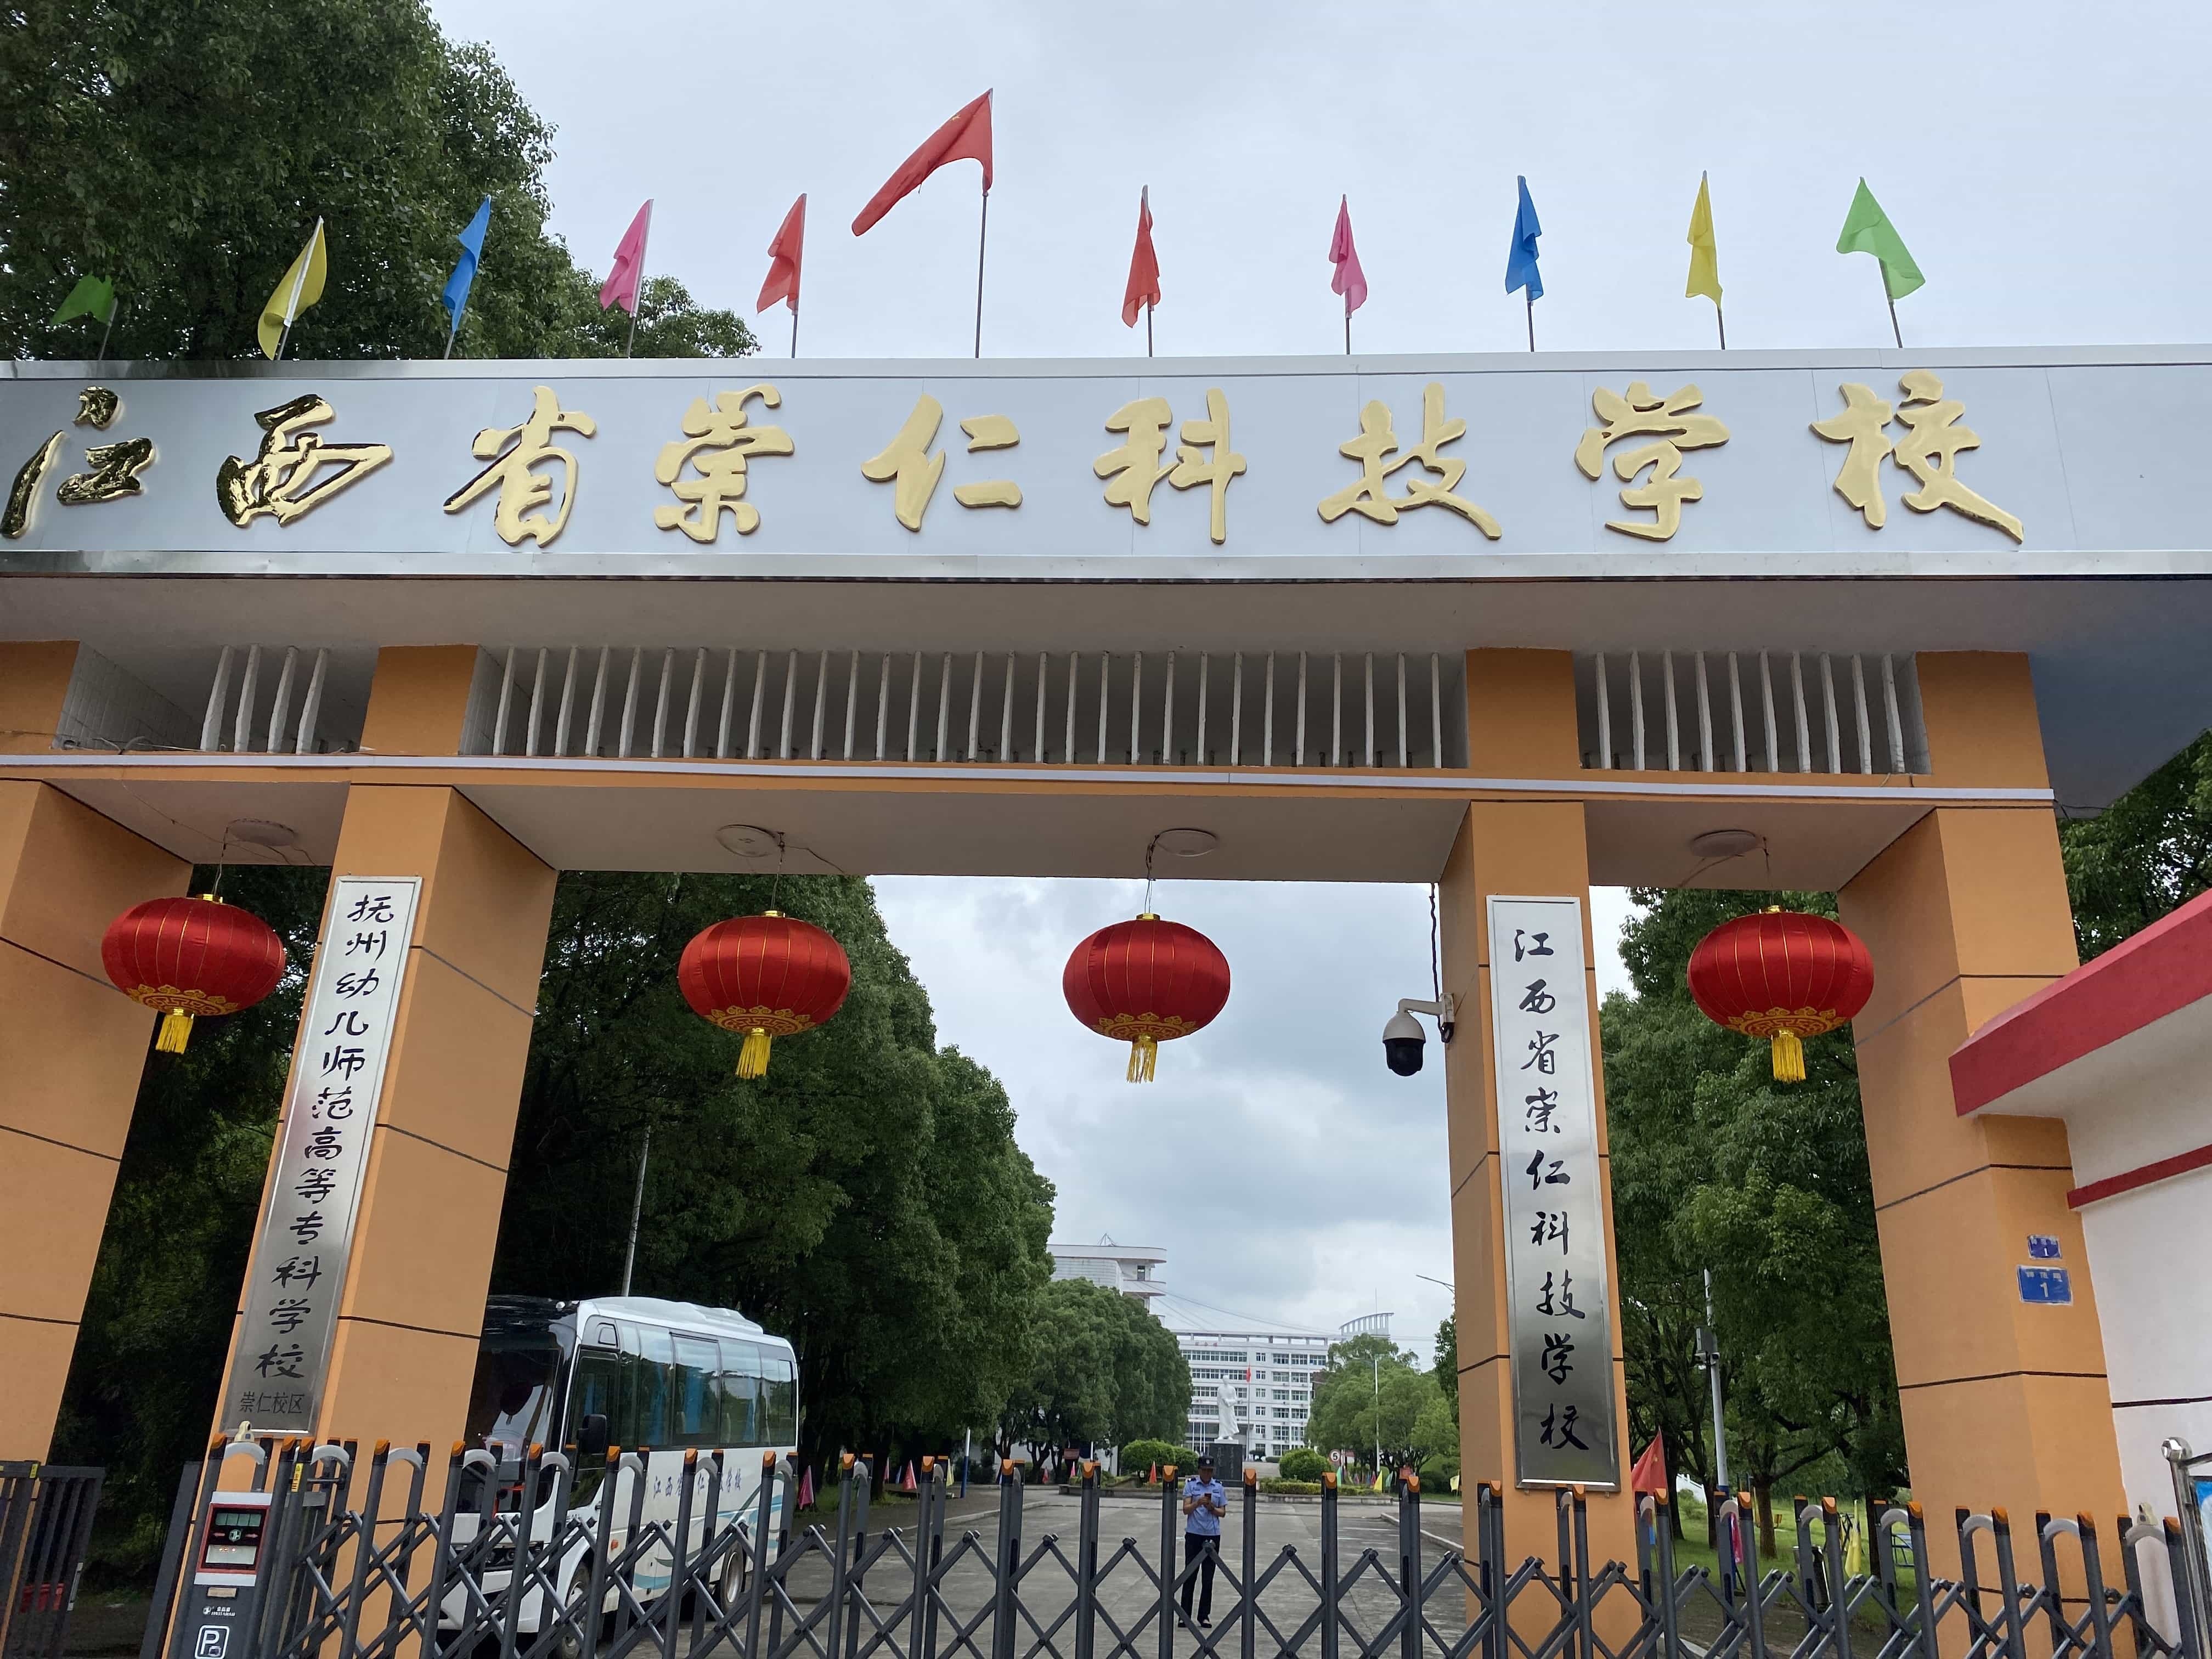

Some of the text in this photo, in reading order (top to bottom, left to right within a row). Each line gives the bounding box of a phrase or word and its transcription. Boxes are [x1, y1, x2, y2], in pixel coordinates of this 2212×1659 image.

[0, 370, 2024, 547] 江西省崇仁科技学校
[254, 893, 394, 1379] 抚州幼儿师范高等专科学校
[1513, 928, 1590, 1452] 江西省崇仁科技学校
[2040, 1282, 2049, 1297] 1
[239, 1391, 305, 1414] 崇仁校区
[200, 1630, 220, 1655] P
